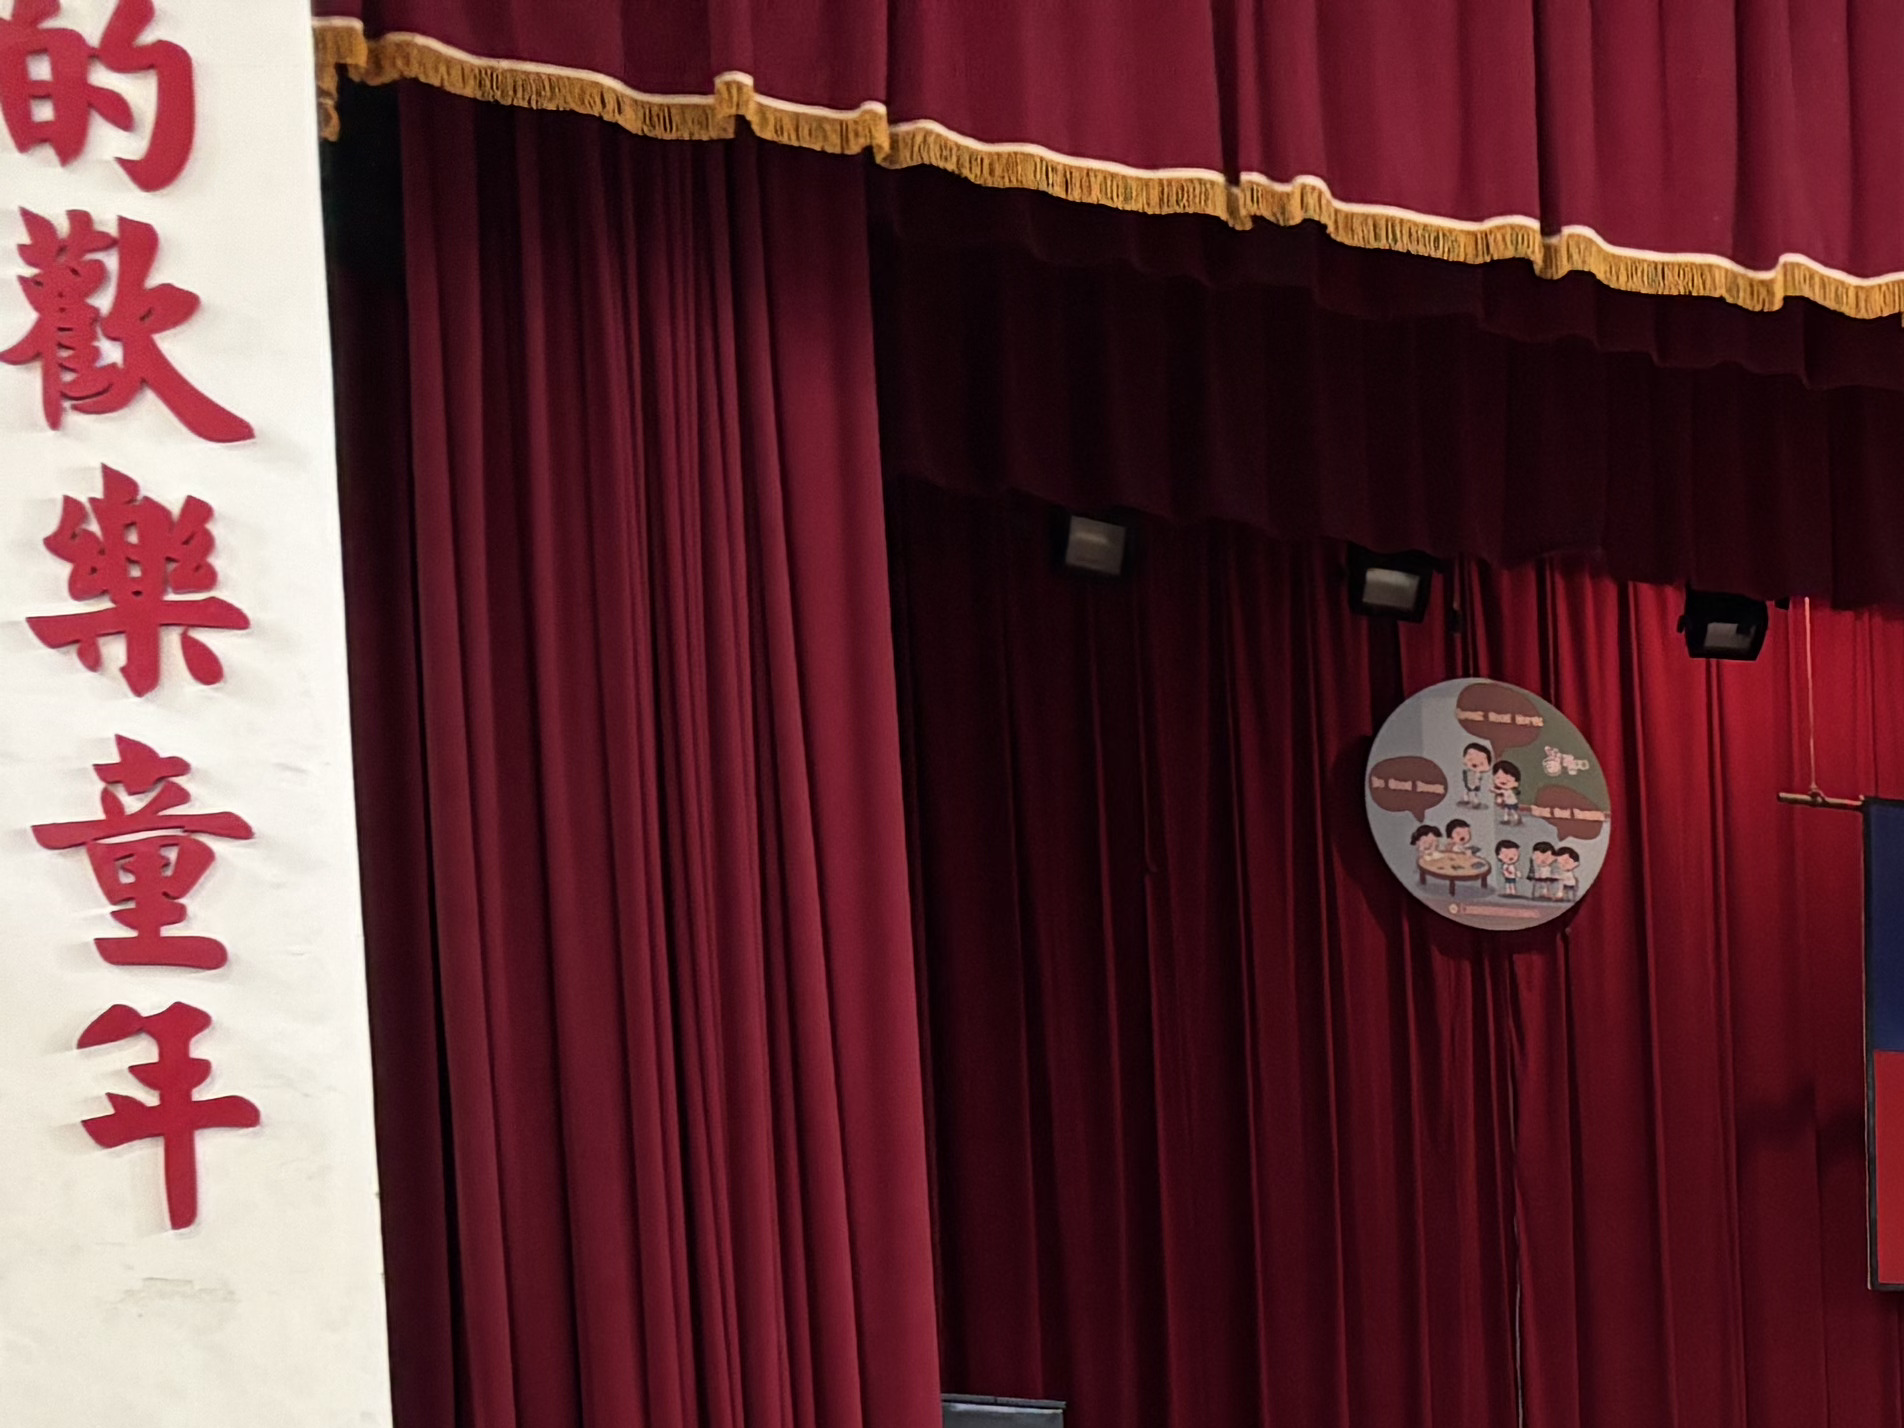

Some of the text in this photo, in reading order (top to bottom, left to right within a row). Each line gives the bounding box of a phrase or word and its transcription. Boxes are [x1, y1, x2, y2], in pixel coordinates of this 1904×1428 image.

[0, 0, 262, 1232] 的歡樂童年
